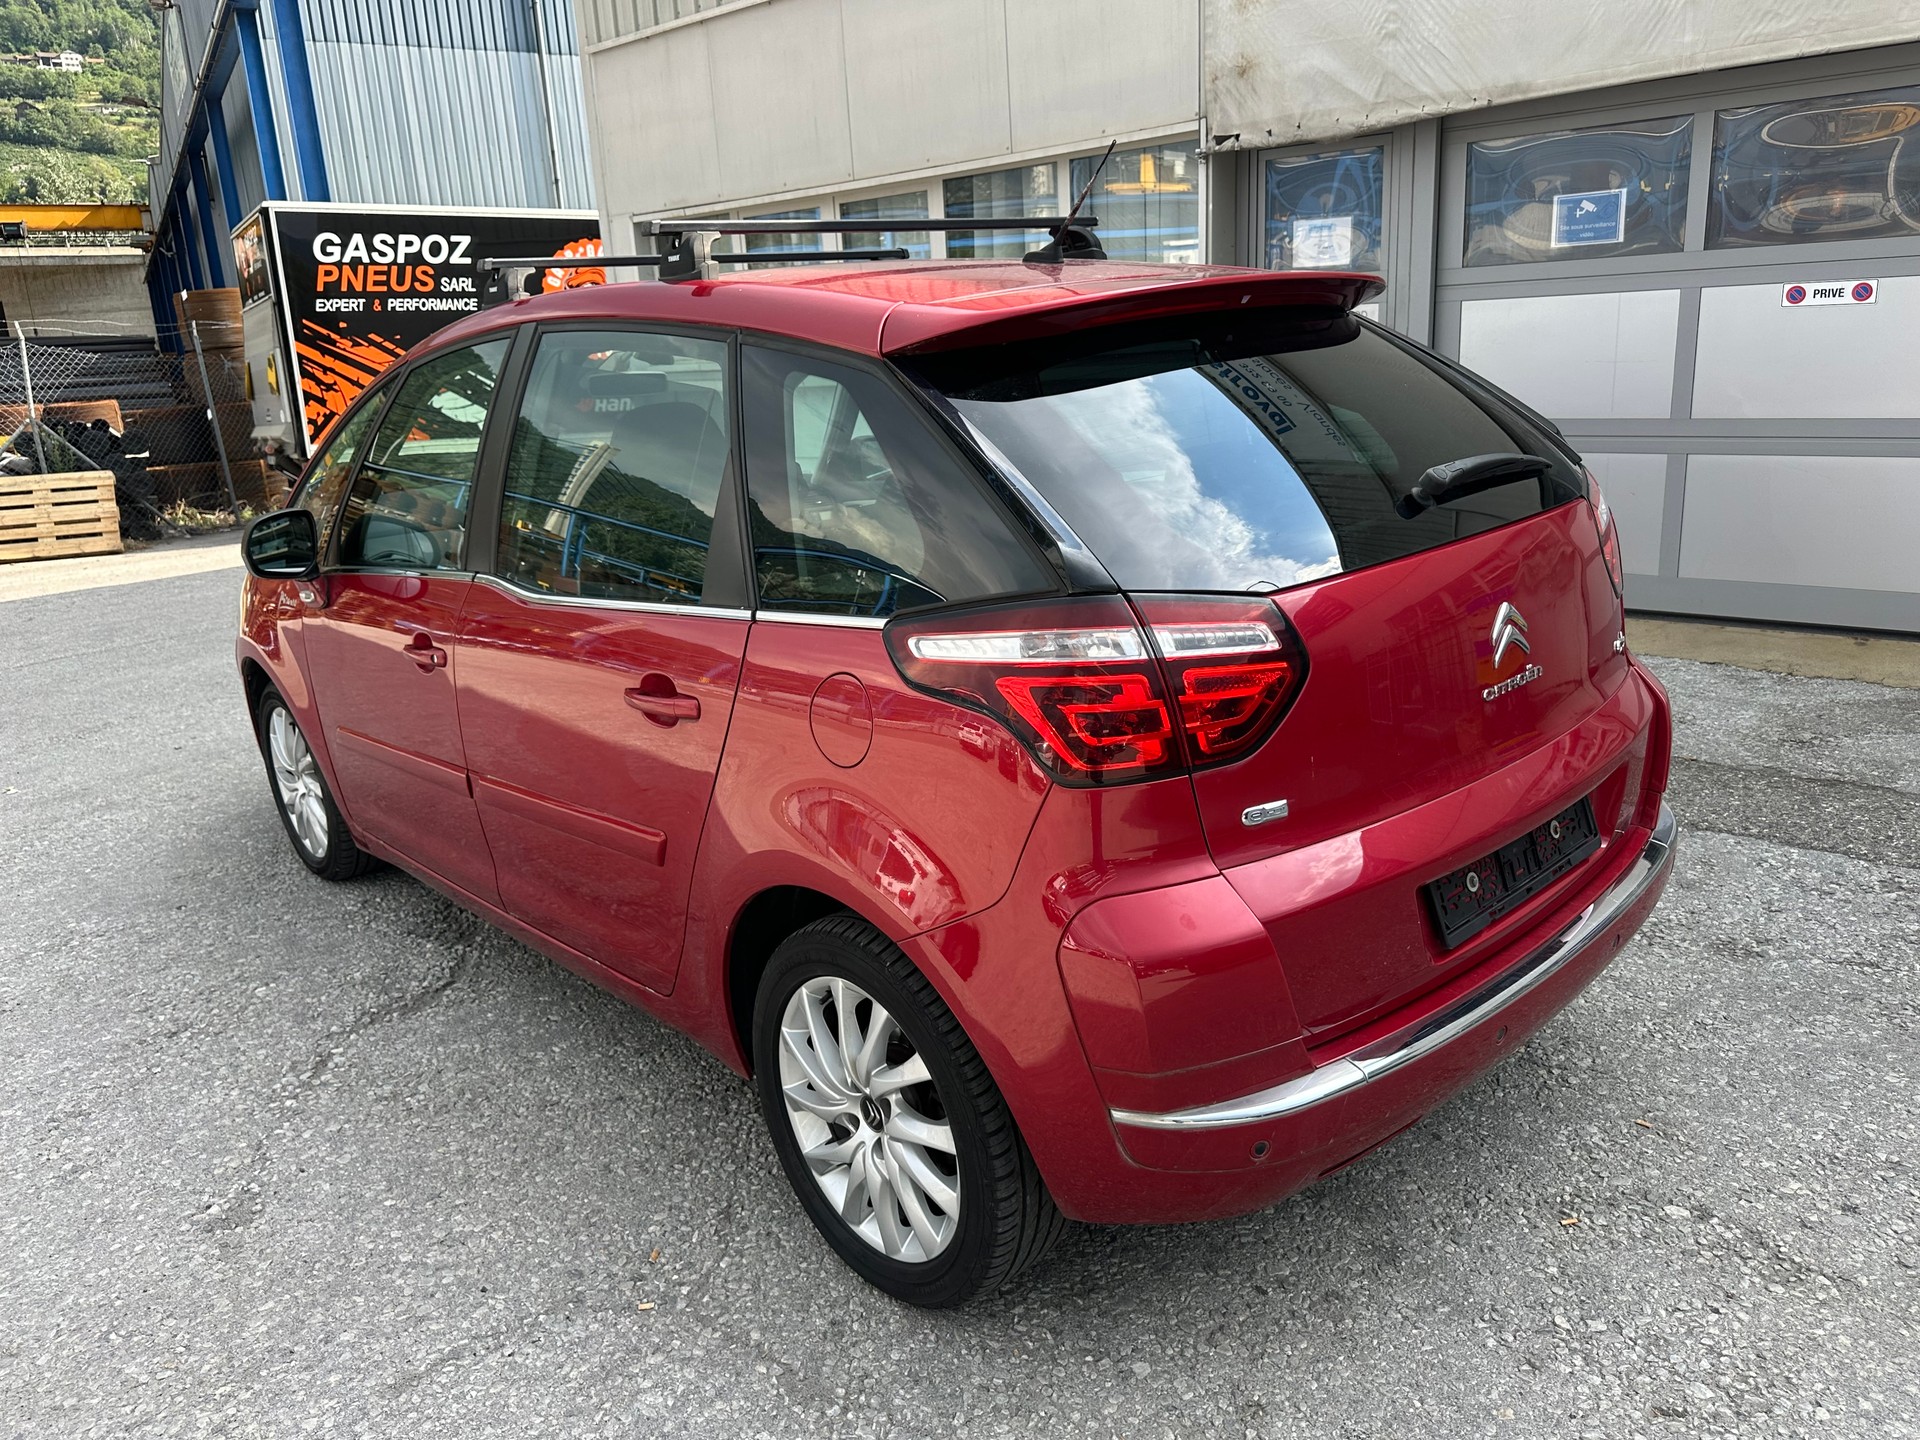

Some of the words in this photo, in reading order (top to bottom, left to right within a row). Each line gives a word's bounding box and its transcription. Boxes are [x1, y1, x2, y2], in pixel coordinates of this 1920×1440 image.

[312, 231, 473, 265] GASPOZ
[316, 264, 436, 292] PNEUS
[440, 277, 477, 292] SARL
[1812, 287, 1846, 299] PRIVE
[315, 298, 367, 312] EXPERT
[372, 299, 383, 312] &
[387, 298, 479, 312] PERFORMANCE
